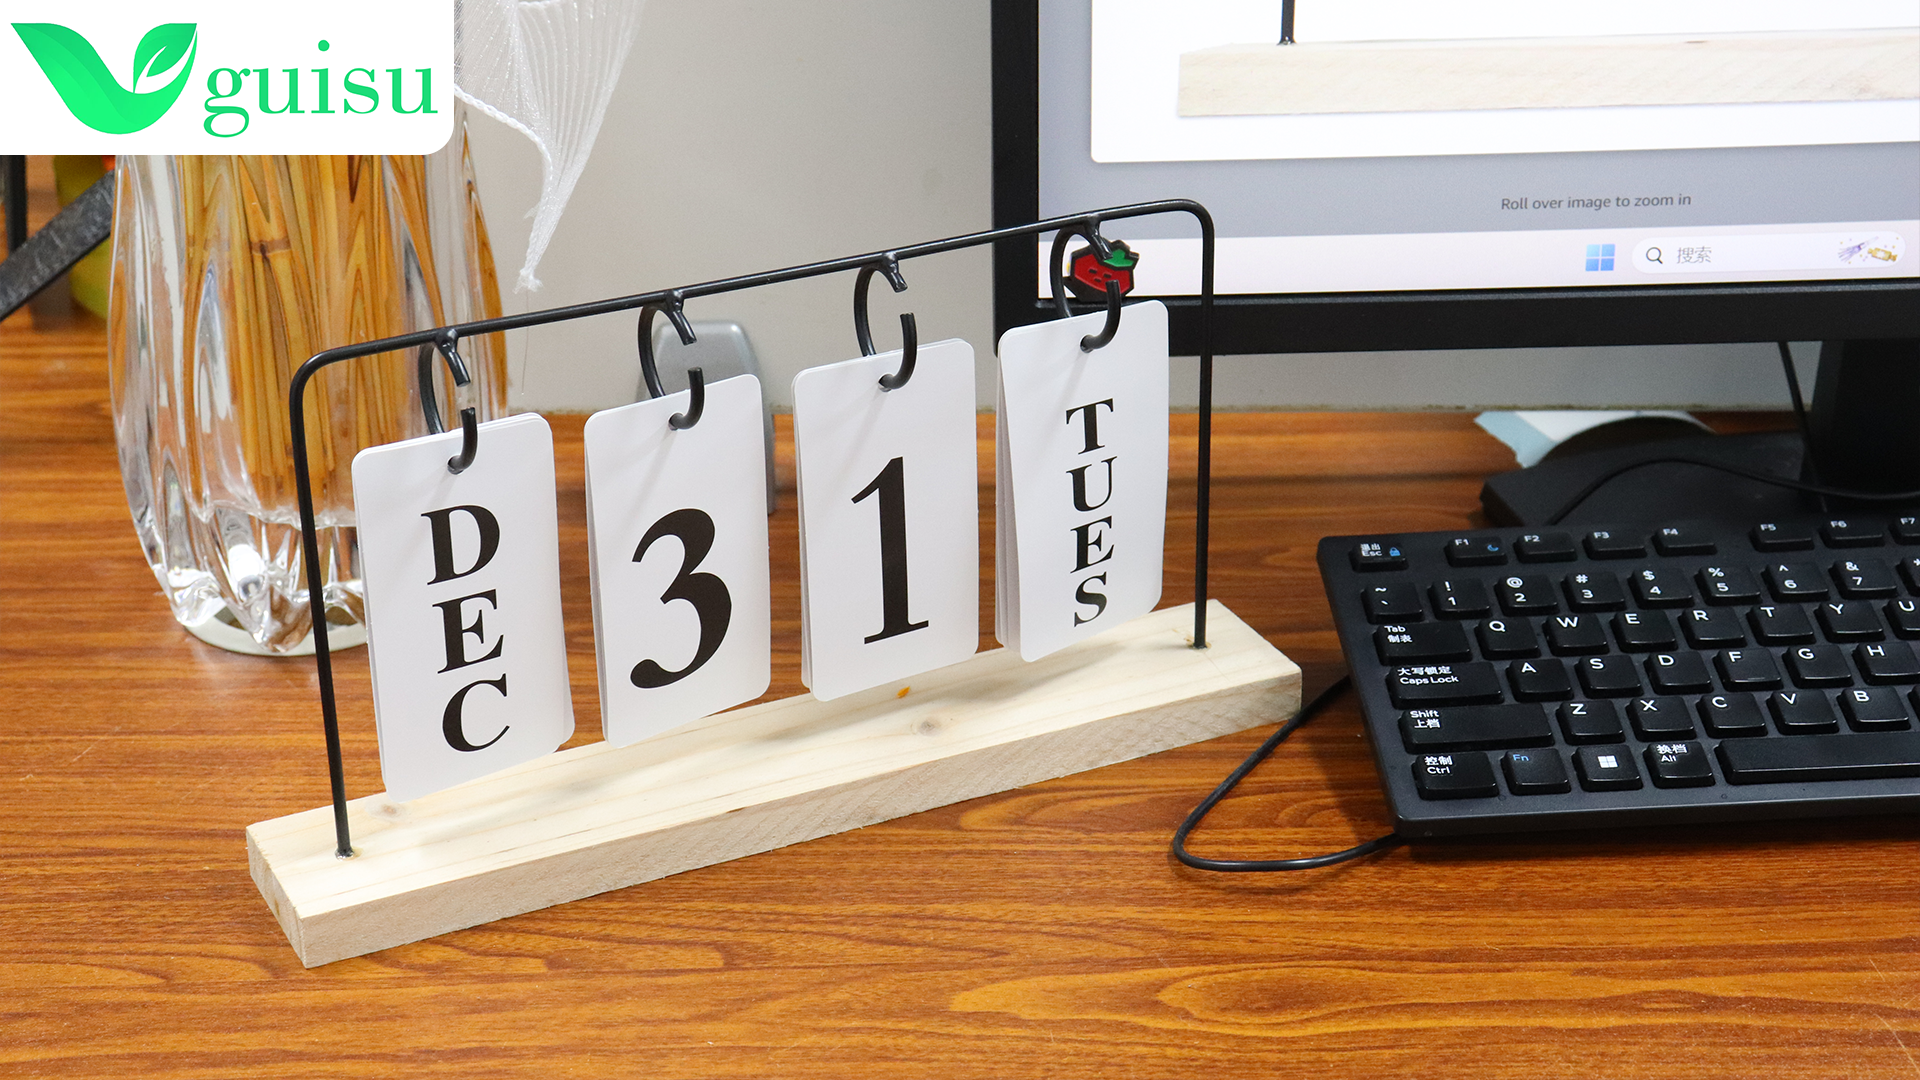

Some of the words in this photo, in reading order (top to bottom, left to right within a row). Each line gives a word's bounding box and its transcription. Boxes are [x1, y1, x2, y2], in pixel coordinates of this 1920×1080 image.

[1501, 198, 1528, 210] Roll
[1532, 199, 1564, 210] over
[1567, 196, 1611, 211] image
[1615, 196, 1631, 208] to
[1634, 194, 1675, 207] zoom
[1678, 193, 1692, 206] in
[1676, 246, 1713, 265] 搜索
[1065, 398, 1118, 628] TUES
[1760, 523, 1777, 531] F5
[1830, 520, 1848, 528] F6
[1900, 517, 1916, 525] F7
[1593, 531, 1610, 539] F3
[1662, 528, 1679, 536] F4
[1454, 538, 1469, 546] F1
[1523, 534, 1541, 543] F2
[851, 456, 929, 645] 1
[1716, 582, 1729, 592] 5
[1784, 579, 1798, 589] 6
[1851, 576, 1863, 586] 7
[1581, 589, 1594, 599] 3
[1649, 585, 1662, 595] 4
[630, 508, 732, 689] 3
[1447, 596, 1457, 606] 1
[1514, 592, 1527, 602] 2
[1760, 606, 1775, 618] T
[1828, 603, 1844, 615] Y
[1898, 600, 1915, 612] U
[1624, 613, 1641, 625] E
[1692, 609, 1709, 621] R
[1488, 620, 1506, 633] Q
[1555, 616, 1579, 628] W
[420, 505, 511, 752] DEC
[1384, 625, 1406, 633] Tab
[1728, 651, 1742, 663] F
[1797, 647, 1815, 660] G
[1866, 645, 1885, 657] H
[1589, 657, 1604, 670] S
[1657, 654, 1675, 666] D
[1397, 665, 1453, 677] 大写锁定
[1521, 661, 1537, 674] A
[1399, 676, 1430, 686] Caps
[1430, 675, 1460, 684] Lock
[1780, 692, 1797, 705] V
[1853, 690, 1870, 702] B
[1639, 699, 1658, 712] X
[1711, 696, 1728, 709] C
[1410, 709, 1440, 718] Shift
[1569, 703, 1587, 716] Z
[1414, 718, 1441, 729] 上档
[1424, 755, 1454, 766] 控制
[1512, 754, 1530, 762] Fn
[1426, 765, 1451, 775] Ctrl
